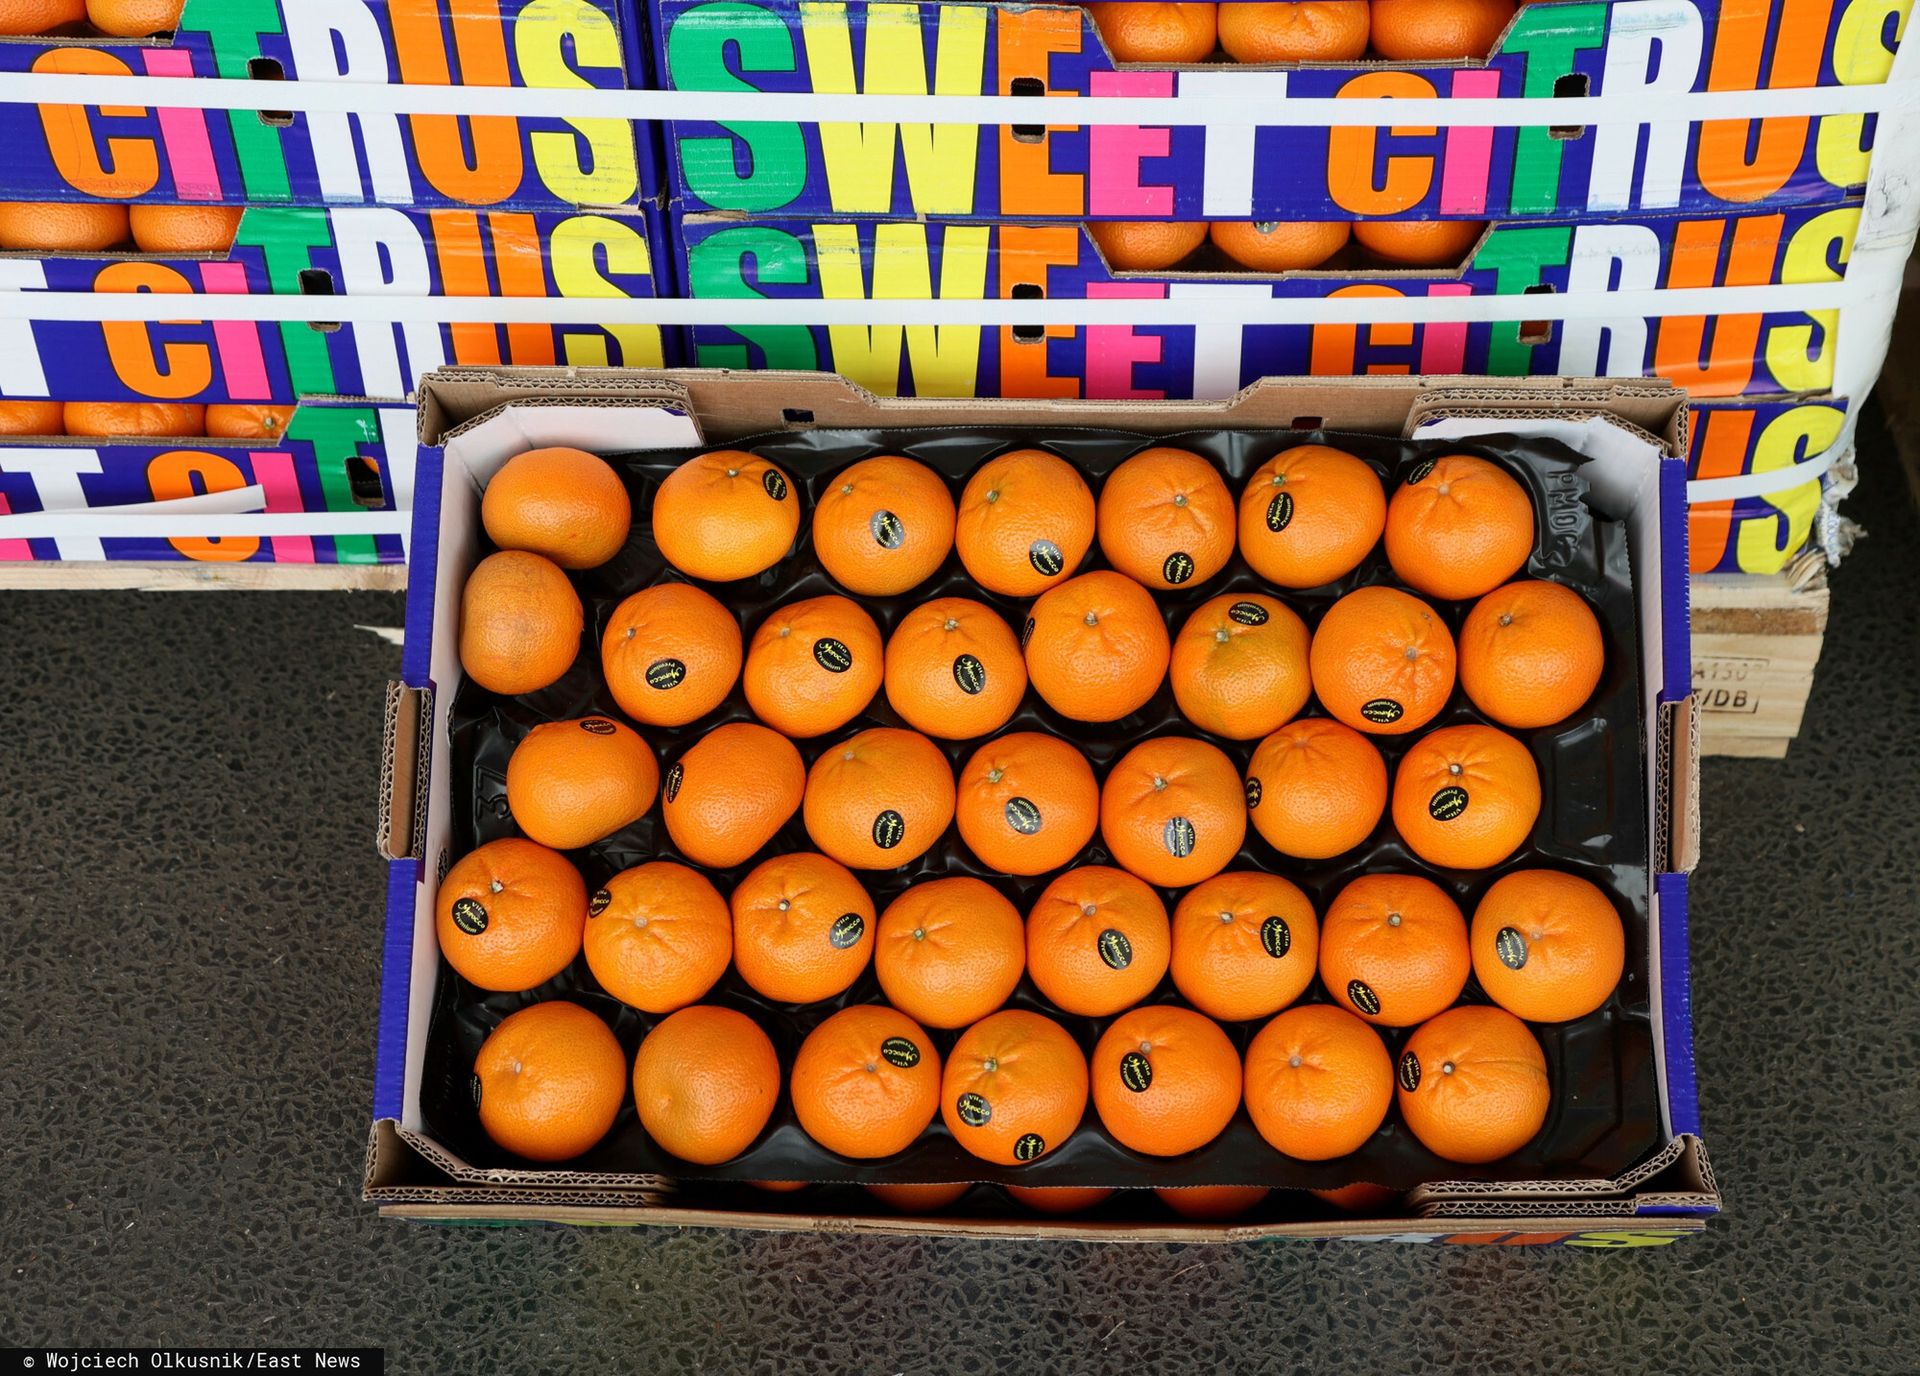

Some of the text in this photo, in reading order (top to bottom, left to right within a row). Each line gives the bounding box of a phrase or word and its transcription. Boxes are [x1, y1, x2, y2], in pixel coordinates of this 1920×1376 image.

[30, 0, 638, 205] CITRUS
[667, 0, 1907, 216] SWEET CITRUS
[93, 207, 665, 400] CITRUS
[689, 222, 1273, 399] SWEET
[146, 406, 413, 563] CIT
[892, 517, 902, 532] Vita
[819, 643, 849, 666] Morocco
[833, 641, 847, 653] Vita
[817, 652, 841, 670] Premium
[957, 665, 971, 691] Premium
[1432, 790, 1458, 806] Premium
[1434, 794, 1465, 816] Morocco
[1446, 808, 1461, 818] Vita
[458, 903, 485, 928] Morocco
[471, 902, 484, 915] Vita
[456, 912, 476, 932] Premium
[836, 916, 849, 927] Vita
[1101, 941, 1117, 966] Premium
[960, 1100, 990, 1115] Morocco
